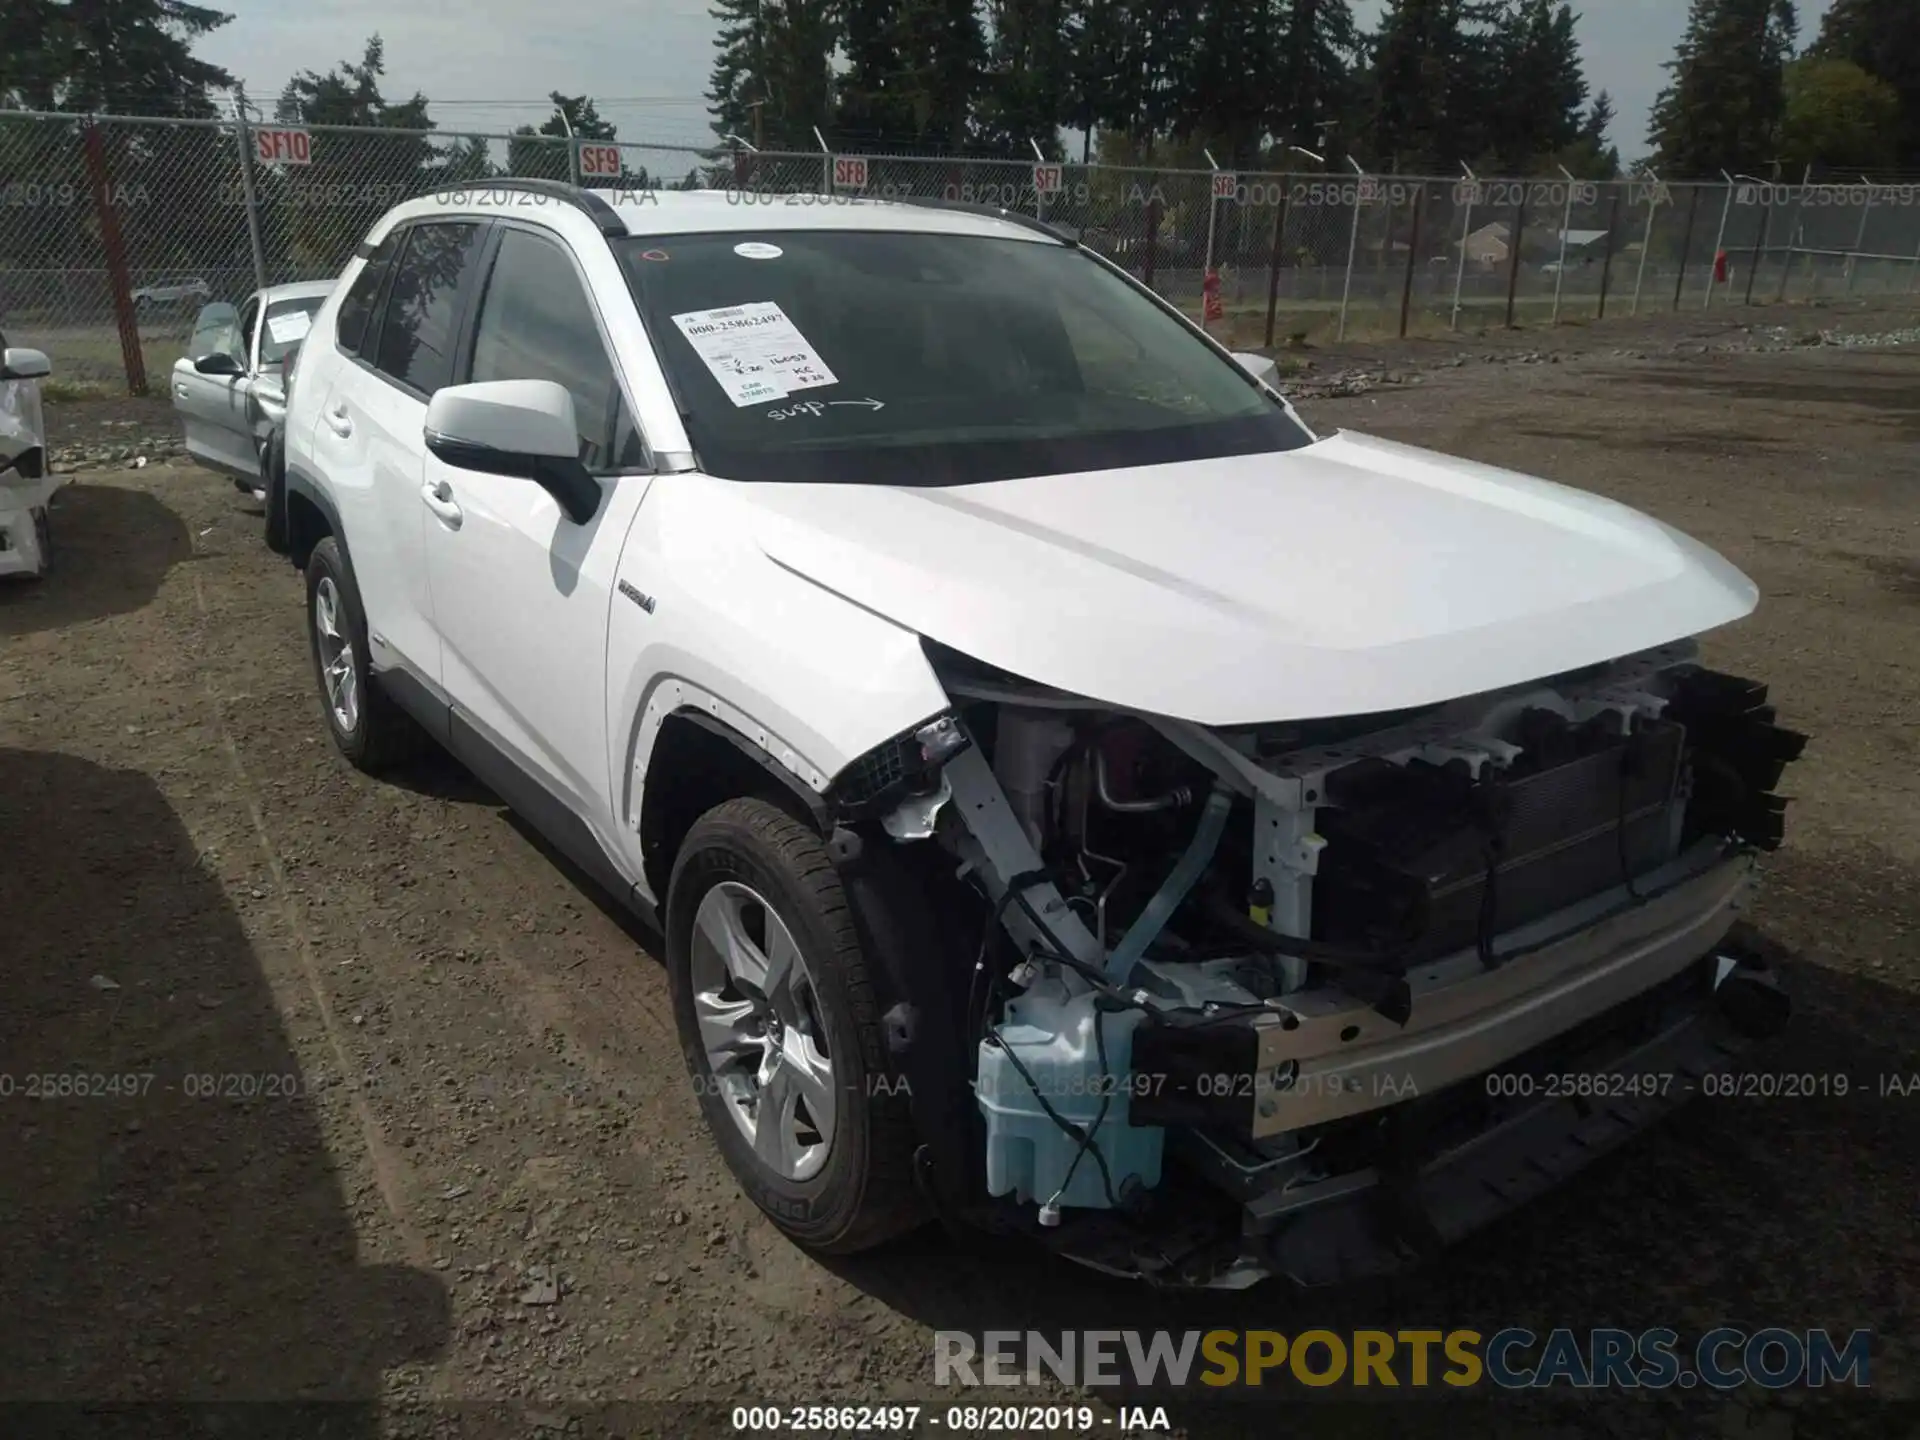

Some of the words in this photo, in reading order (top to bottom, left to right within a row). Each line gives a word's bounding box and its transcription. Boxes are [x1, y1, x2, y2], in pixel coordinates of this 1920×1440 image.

[257, 131, 310, 162] SF10
[582, 147, 619, 173] SF9
[836, 160, 865, 184] SF8
[1035, 167, 1059, 190] SF7
[688, 312, 783, 335] 000-25862497
